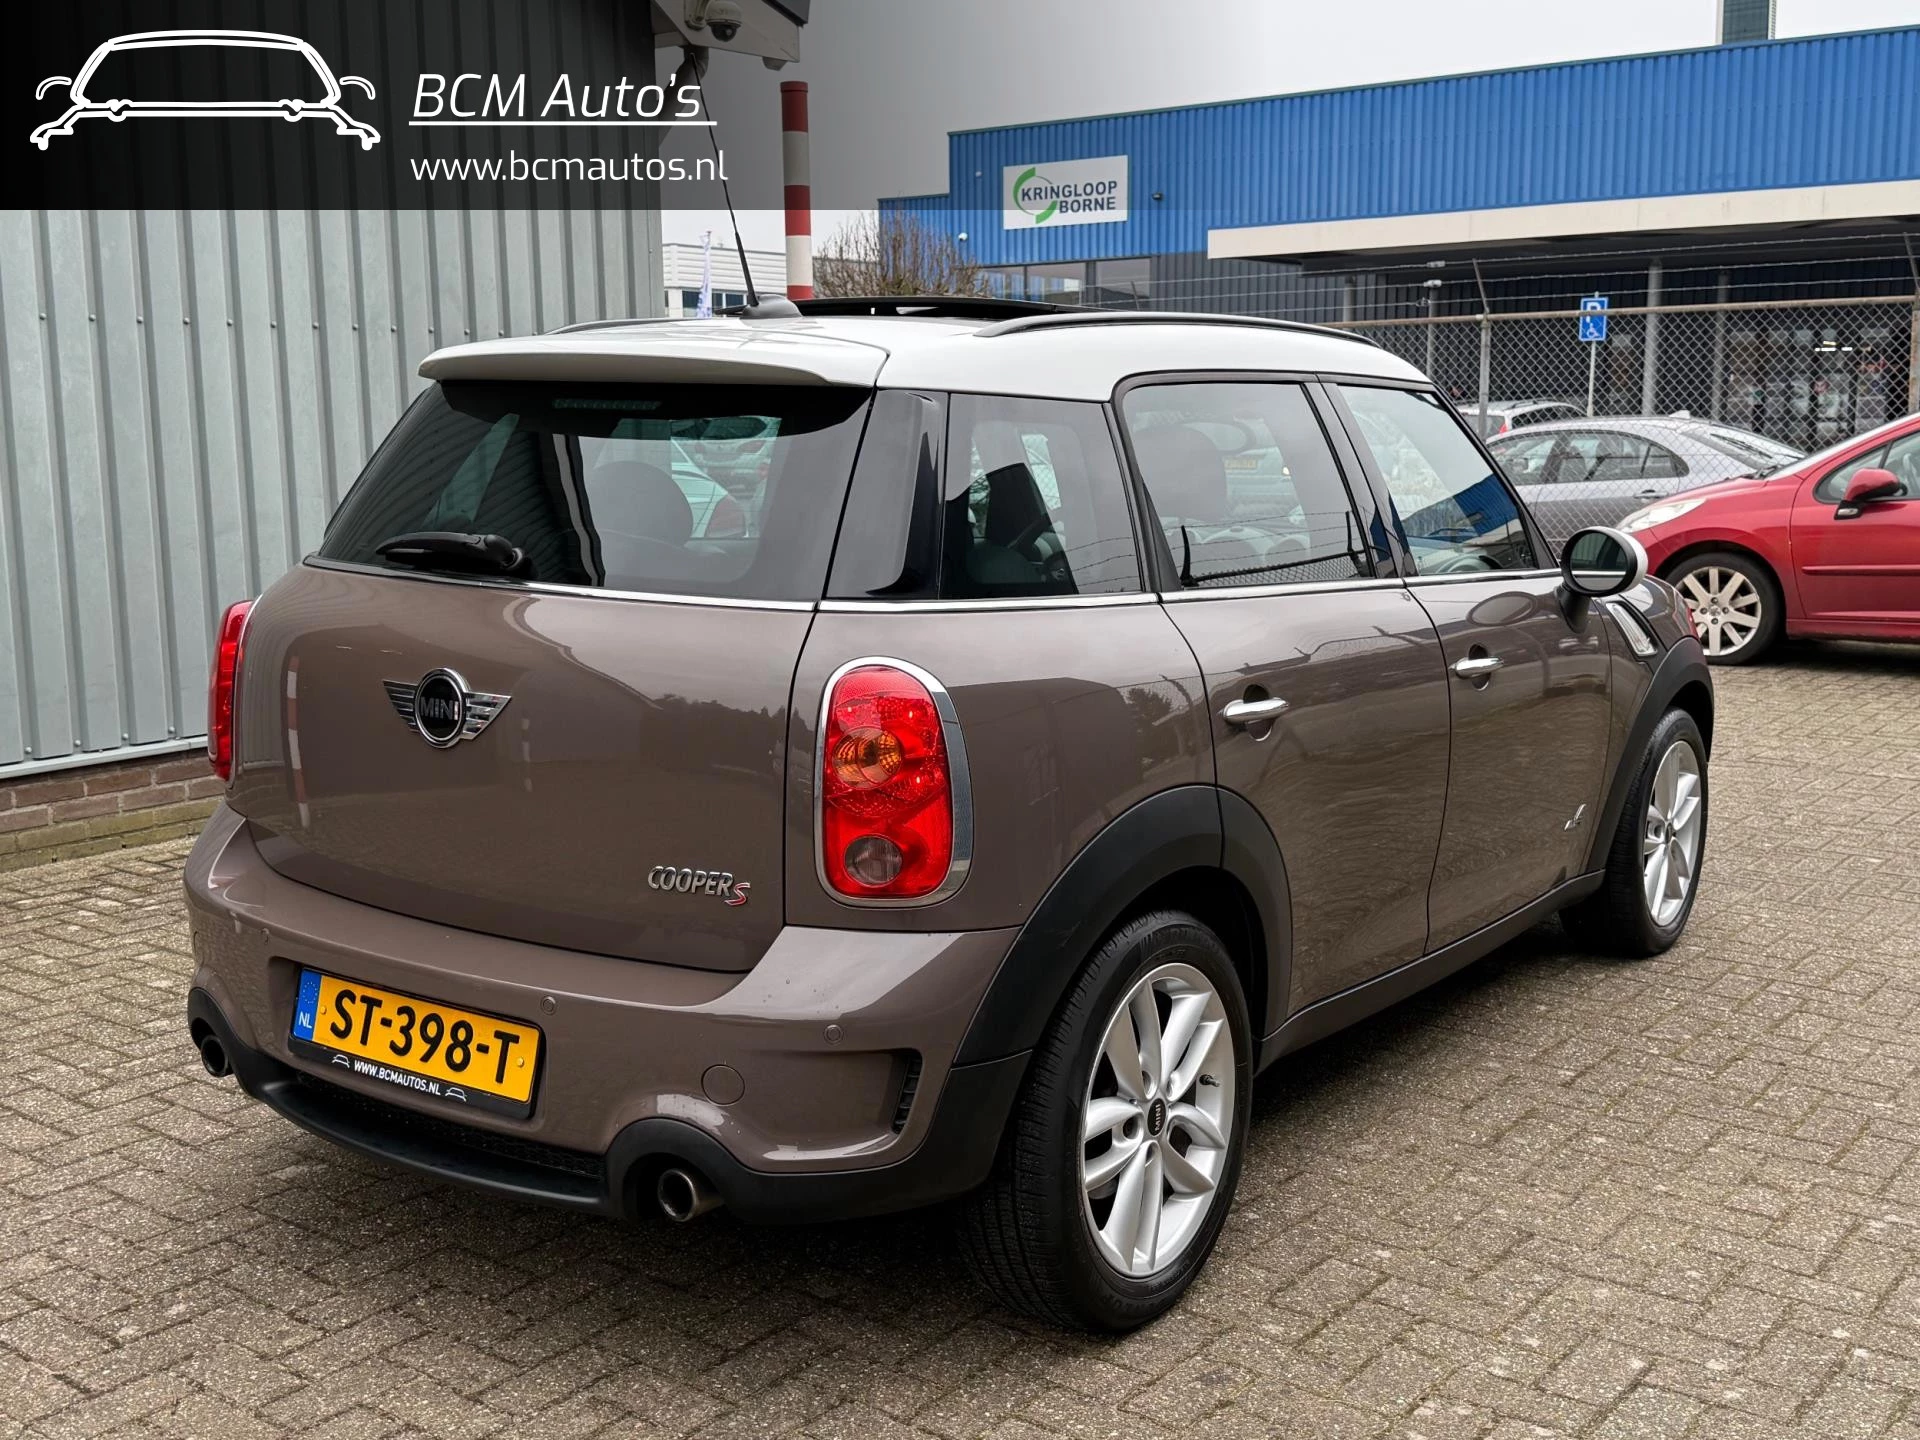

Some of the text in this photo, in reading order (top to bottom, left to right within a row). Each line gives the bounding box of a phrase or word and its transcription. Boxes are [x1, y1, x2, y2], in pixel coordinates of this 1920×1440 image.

[1021, 181, 1117, 201] KRINGLOOP
[1059, 196, 1116, 213] BORNE
[420, 697, 459, 721] MINI
[647, 865, 751, 906] COOPER S
[299, 1011, 312, 1029] NL
[330, 989, 520, 1083] ST-398-T
[353, 1060, 441, 1095] WWW.BCMAUTOS.NL
